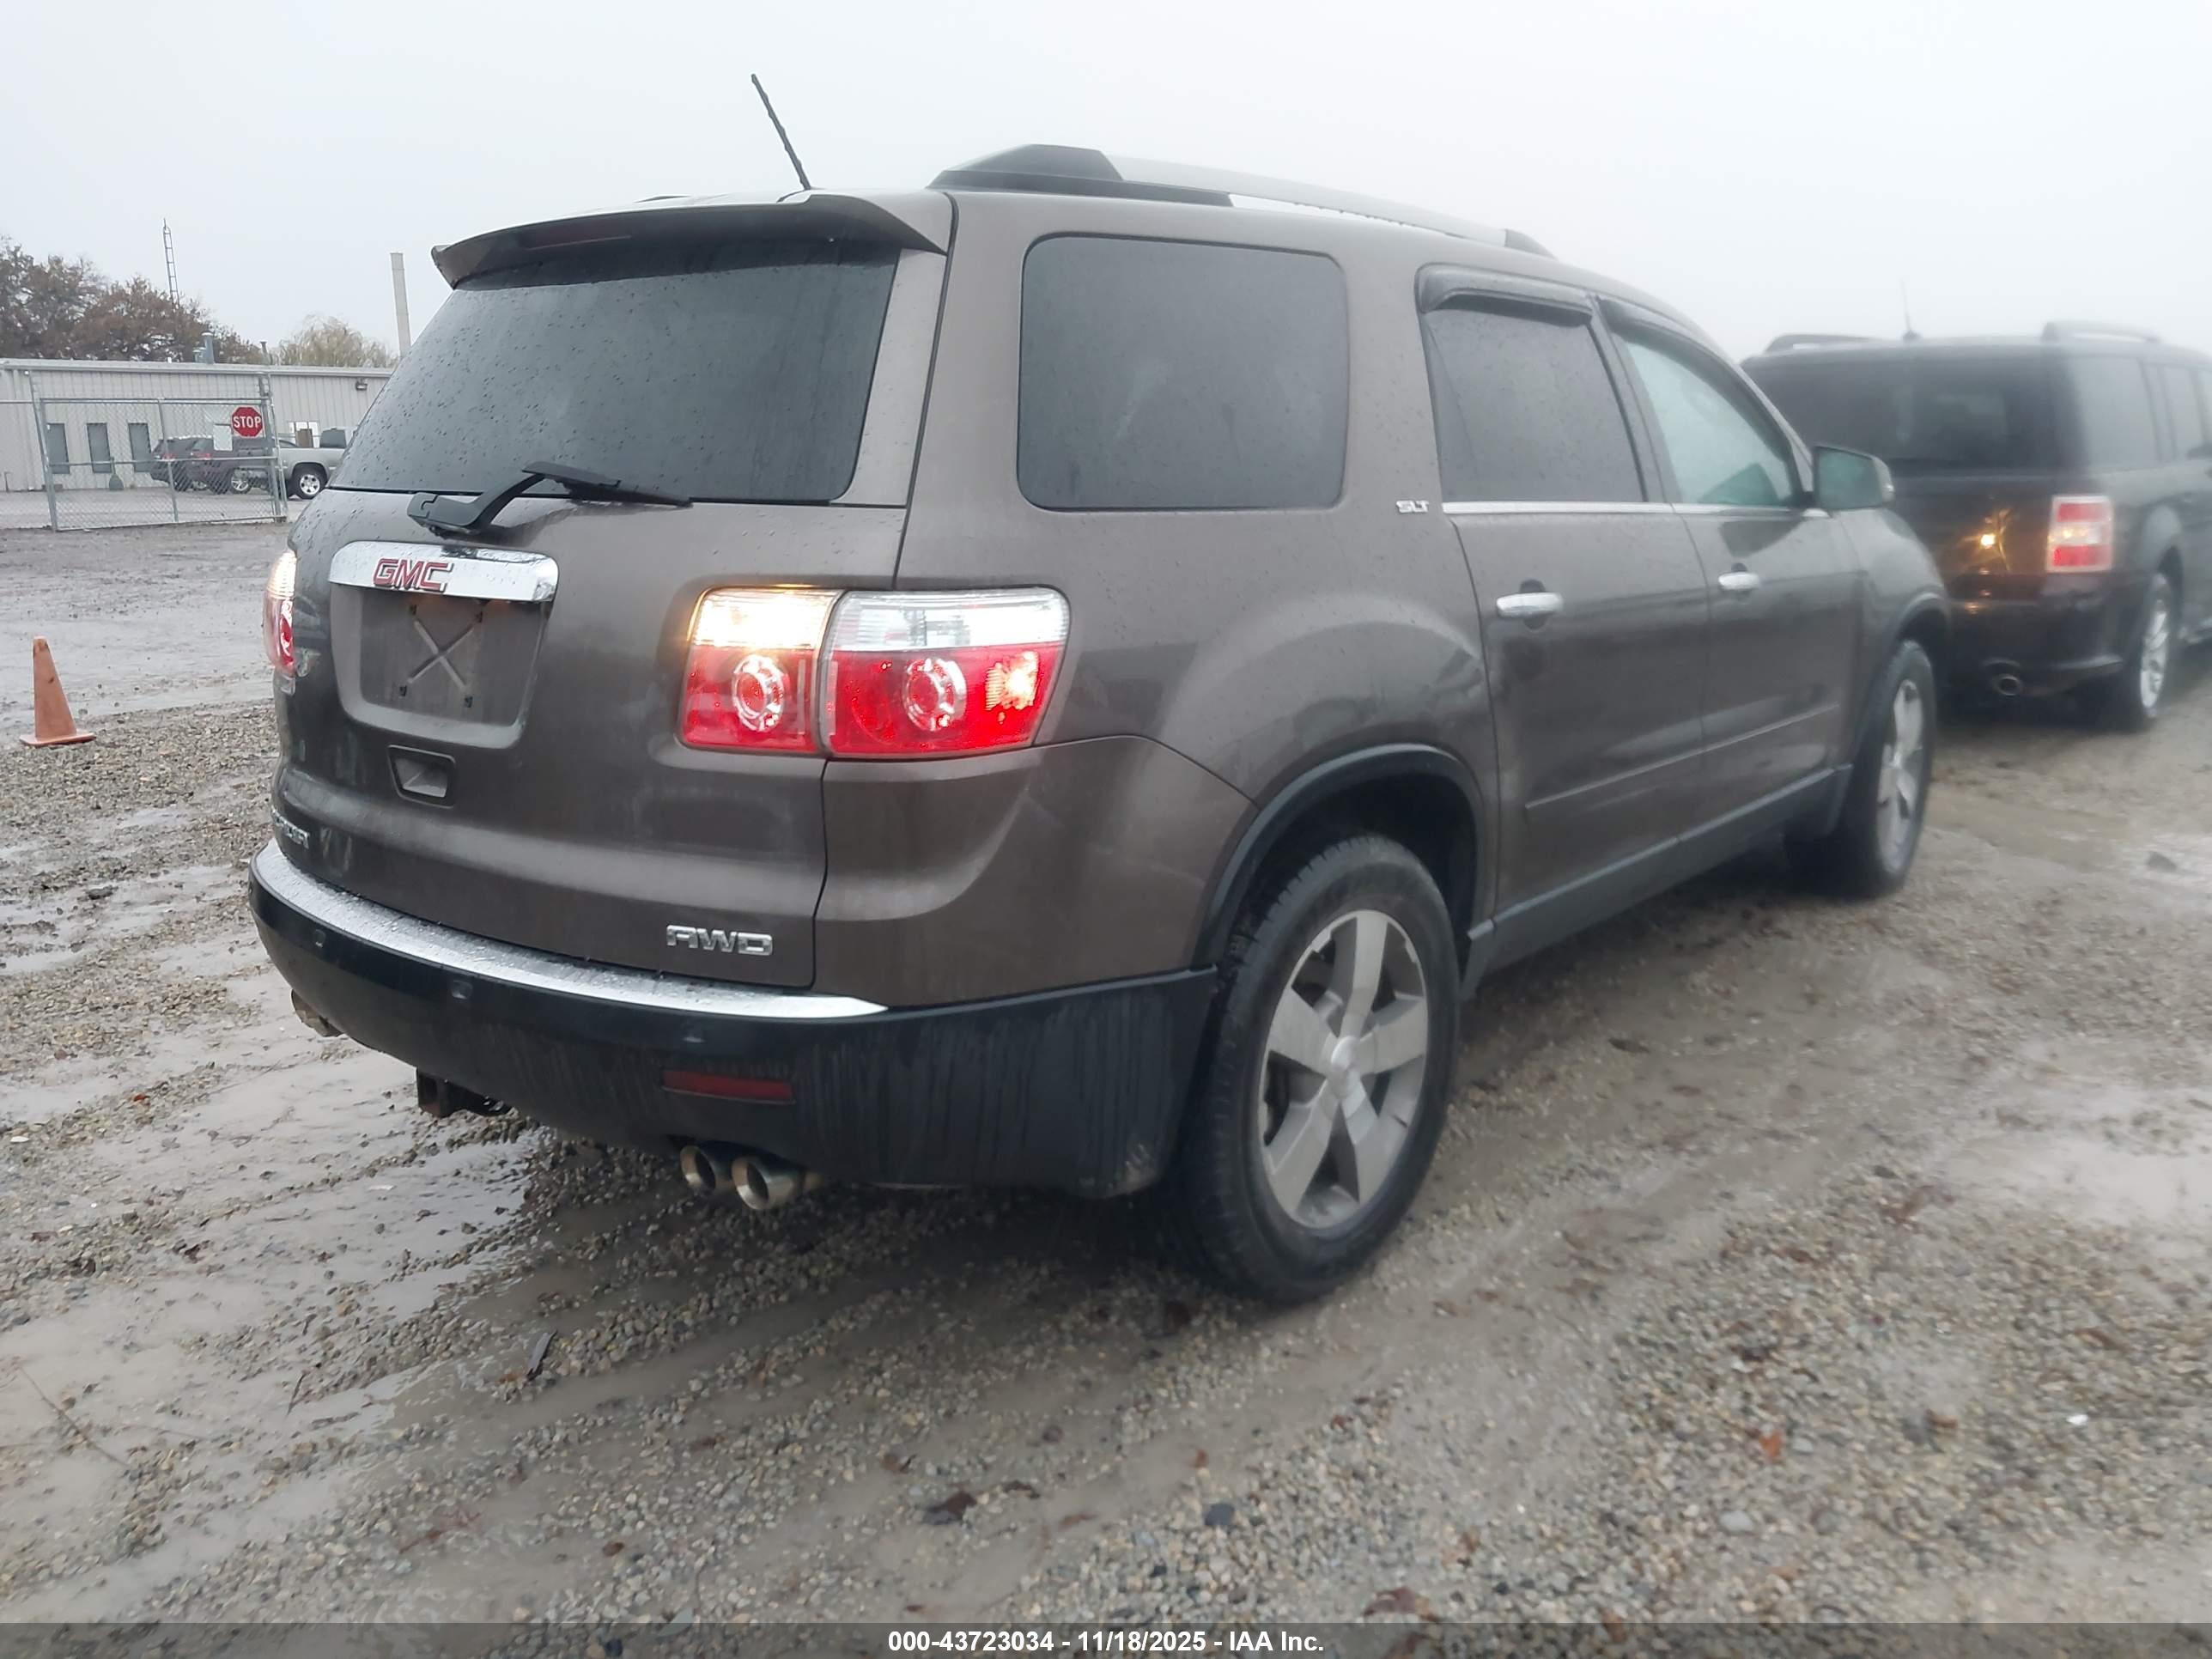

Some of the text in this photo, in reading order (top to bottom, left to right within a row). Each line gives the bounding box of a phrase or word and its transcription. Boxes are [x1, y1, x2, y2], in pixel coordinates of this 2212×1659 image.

[233, 416, 261, 428] STOP
[1396, 500, 1429, 514] SLT
[373, 558, 453, 592] GMC
[666, 924, 773, 956] AWD
